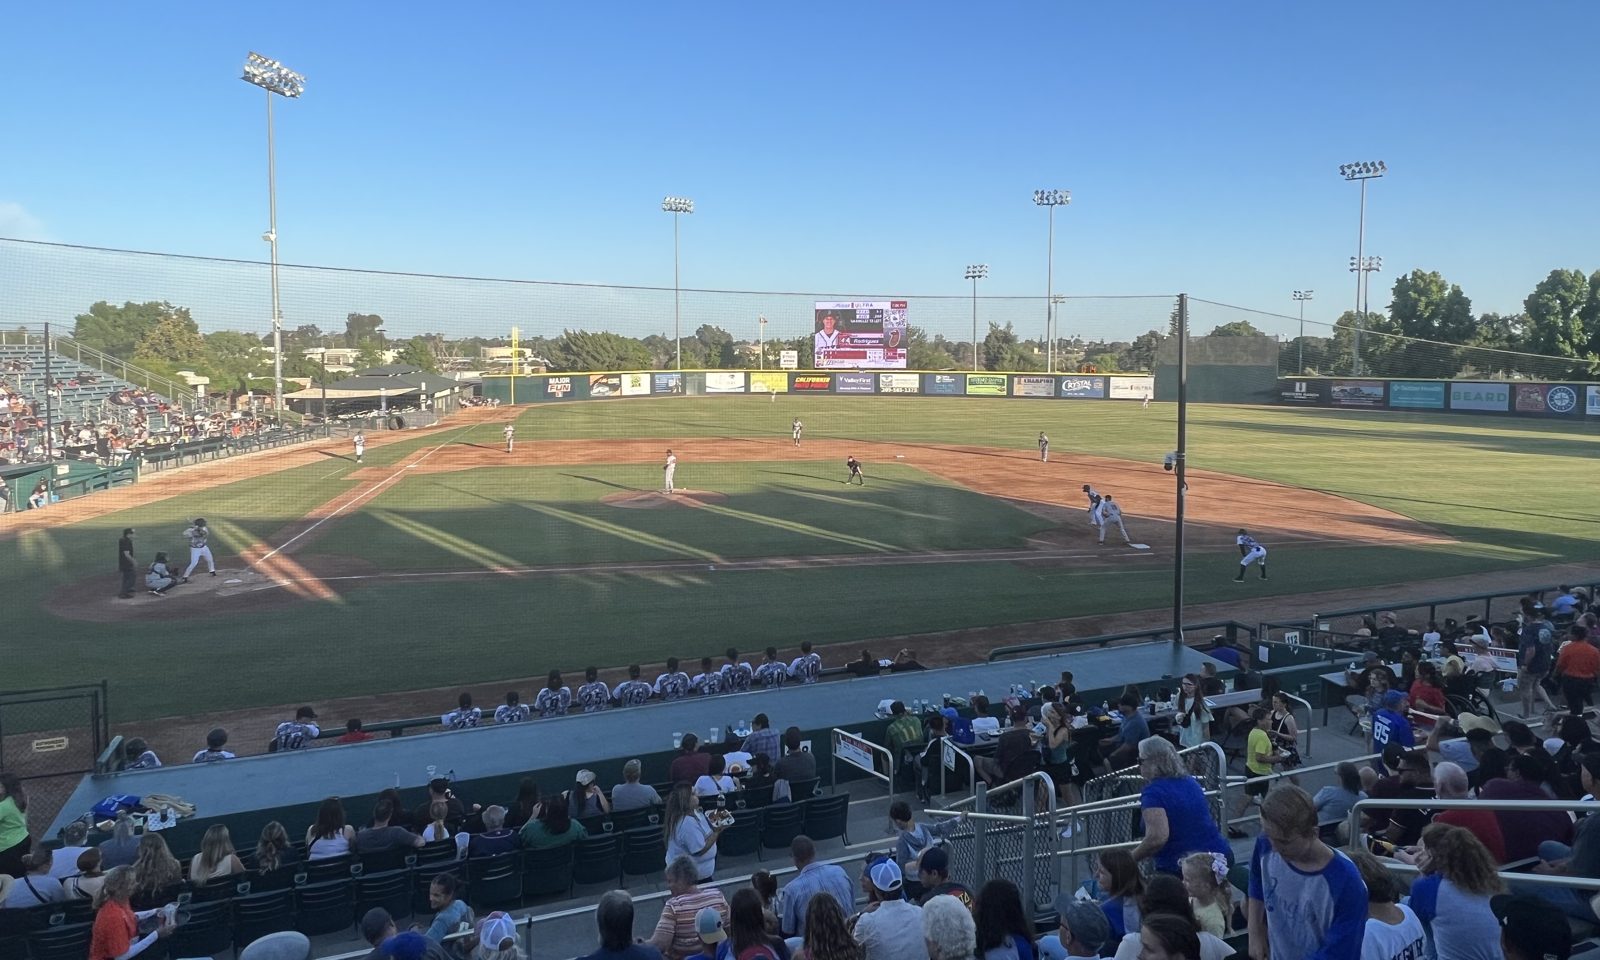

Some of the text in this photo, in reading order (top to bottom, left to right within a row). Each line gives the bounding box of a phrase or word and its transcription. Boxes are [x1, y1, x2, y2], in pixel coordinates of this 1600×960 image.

[549, 377, 571, 385] MAJOR
[1062, 379, 1092, 391] CRYSTAL
[1452, 391, 1507, 402] BEARD
[1287, 635, 1298, 645] 112
[584, 692, 602, 705] 25
[1374, 721, 1391, 744] 85
